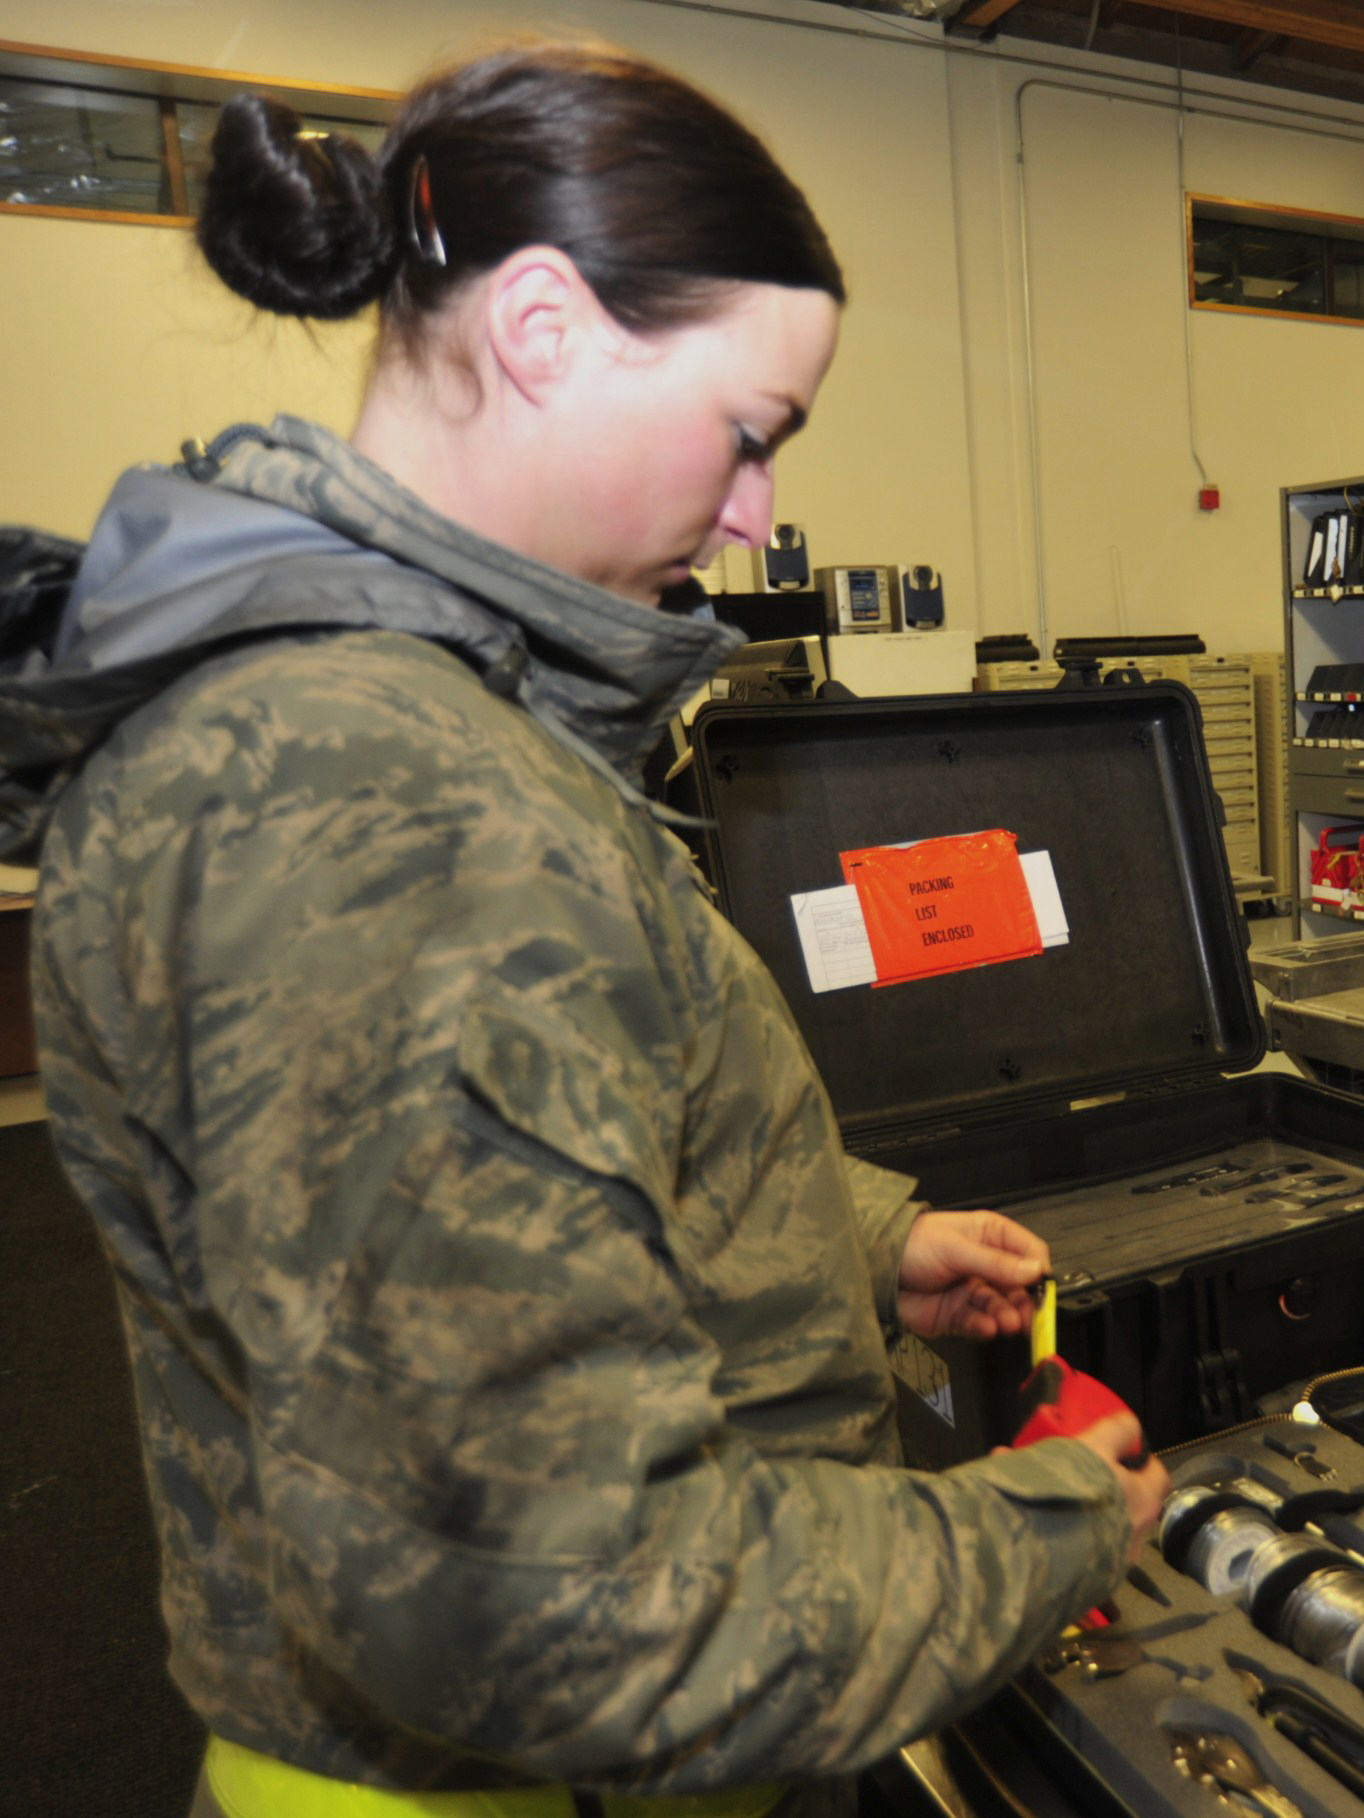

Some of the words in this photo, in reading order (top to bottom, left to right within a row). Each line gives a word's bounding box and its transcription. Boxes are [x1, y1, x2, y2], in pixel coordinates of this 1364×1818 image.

[909, 875, 955, 896] PACKING
[915, 904, 938, 921] LIST
[922, 924, 974, 947] ENCLOSED
